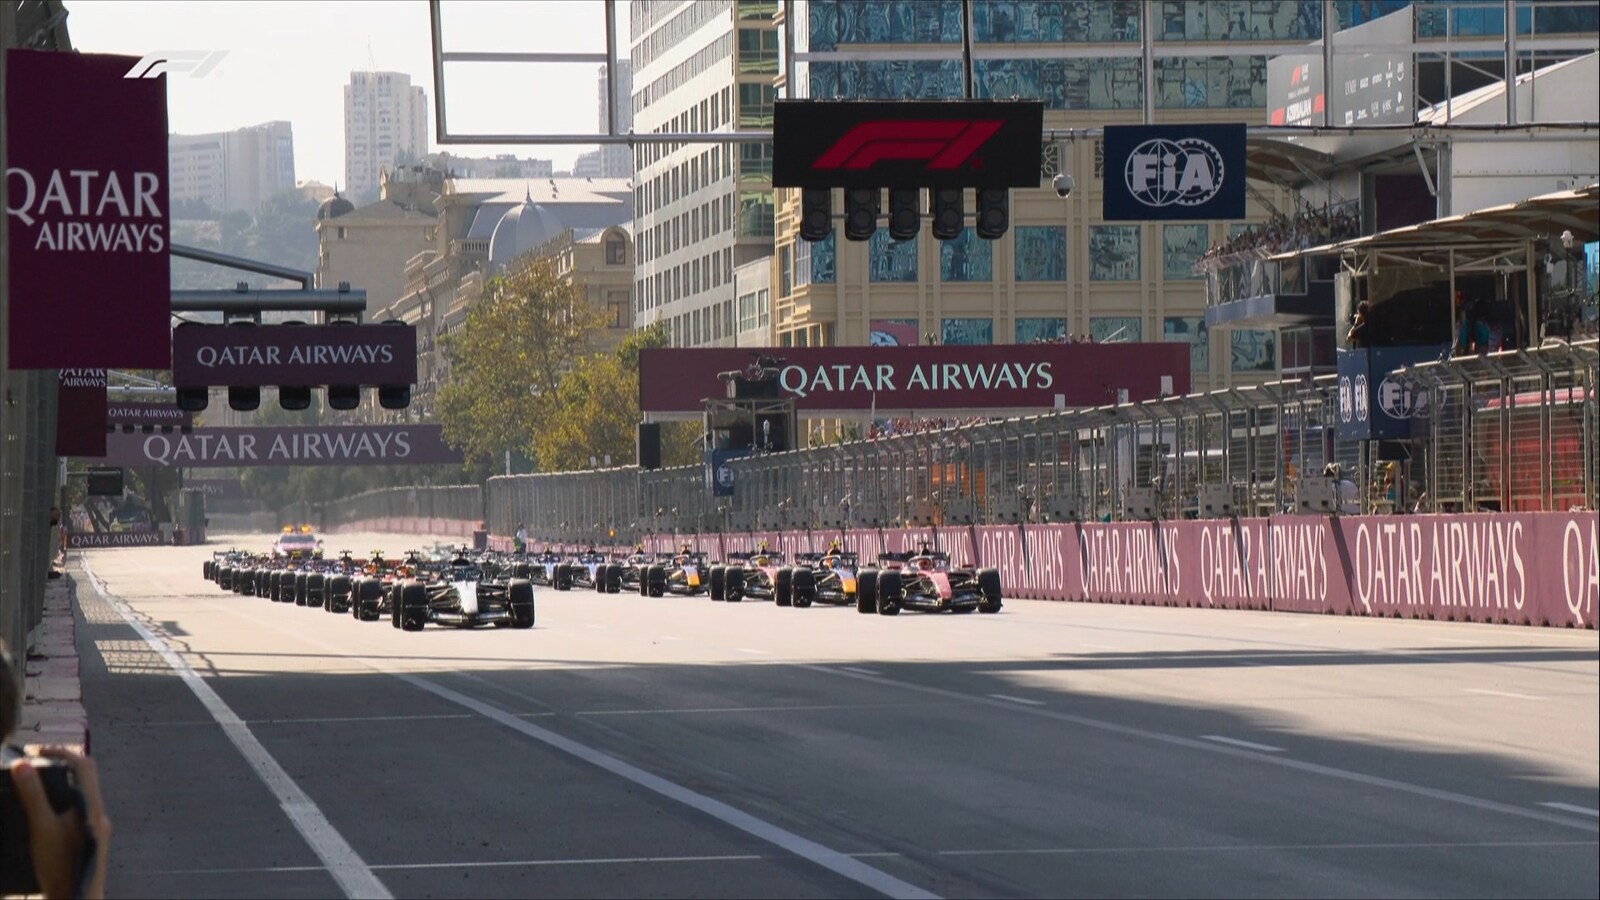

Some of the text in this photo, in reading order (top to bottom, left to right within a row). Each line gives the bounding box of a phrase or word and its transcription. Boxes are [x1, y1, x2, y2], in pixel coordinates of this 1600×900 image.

[6, 167, 162, 226] QATAR
[35, 221, 164, 253] AIRWAYS
[196, 344, 393, 367] QATAR AIRWAYS
[63, 378, 106, 387] AIRWAYS
[780, 362, 1053, 397] QATAR AIRWAYS
[108, 408, 184, 418] QATAR AIRWAYS
[143, 431, 411, 466] QATAR AIRWAYS
[71, 534, 159, 547] QATAR AIRWAYS
[982, 529, 1064, 590] QATAR AIRWAYS
[1080, 527, 1180, 598] QATAR AIRWAYS
[1201, 525, 1328, 605] QATAR AIRWAYS
[1356, 521, 1525, 613] QATAR AIRWAYS
